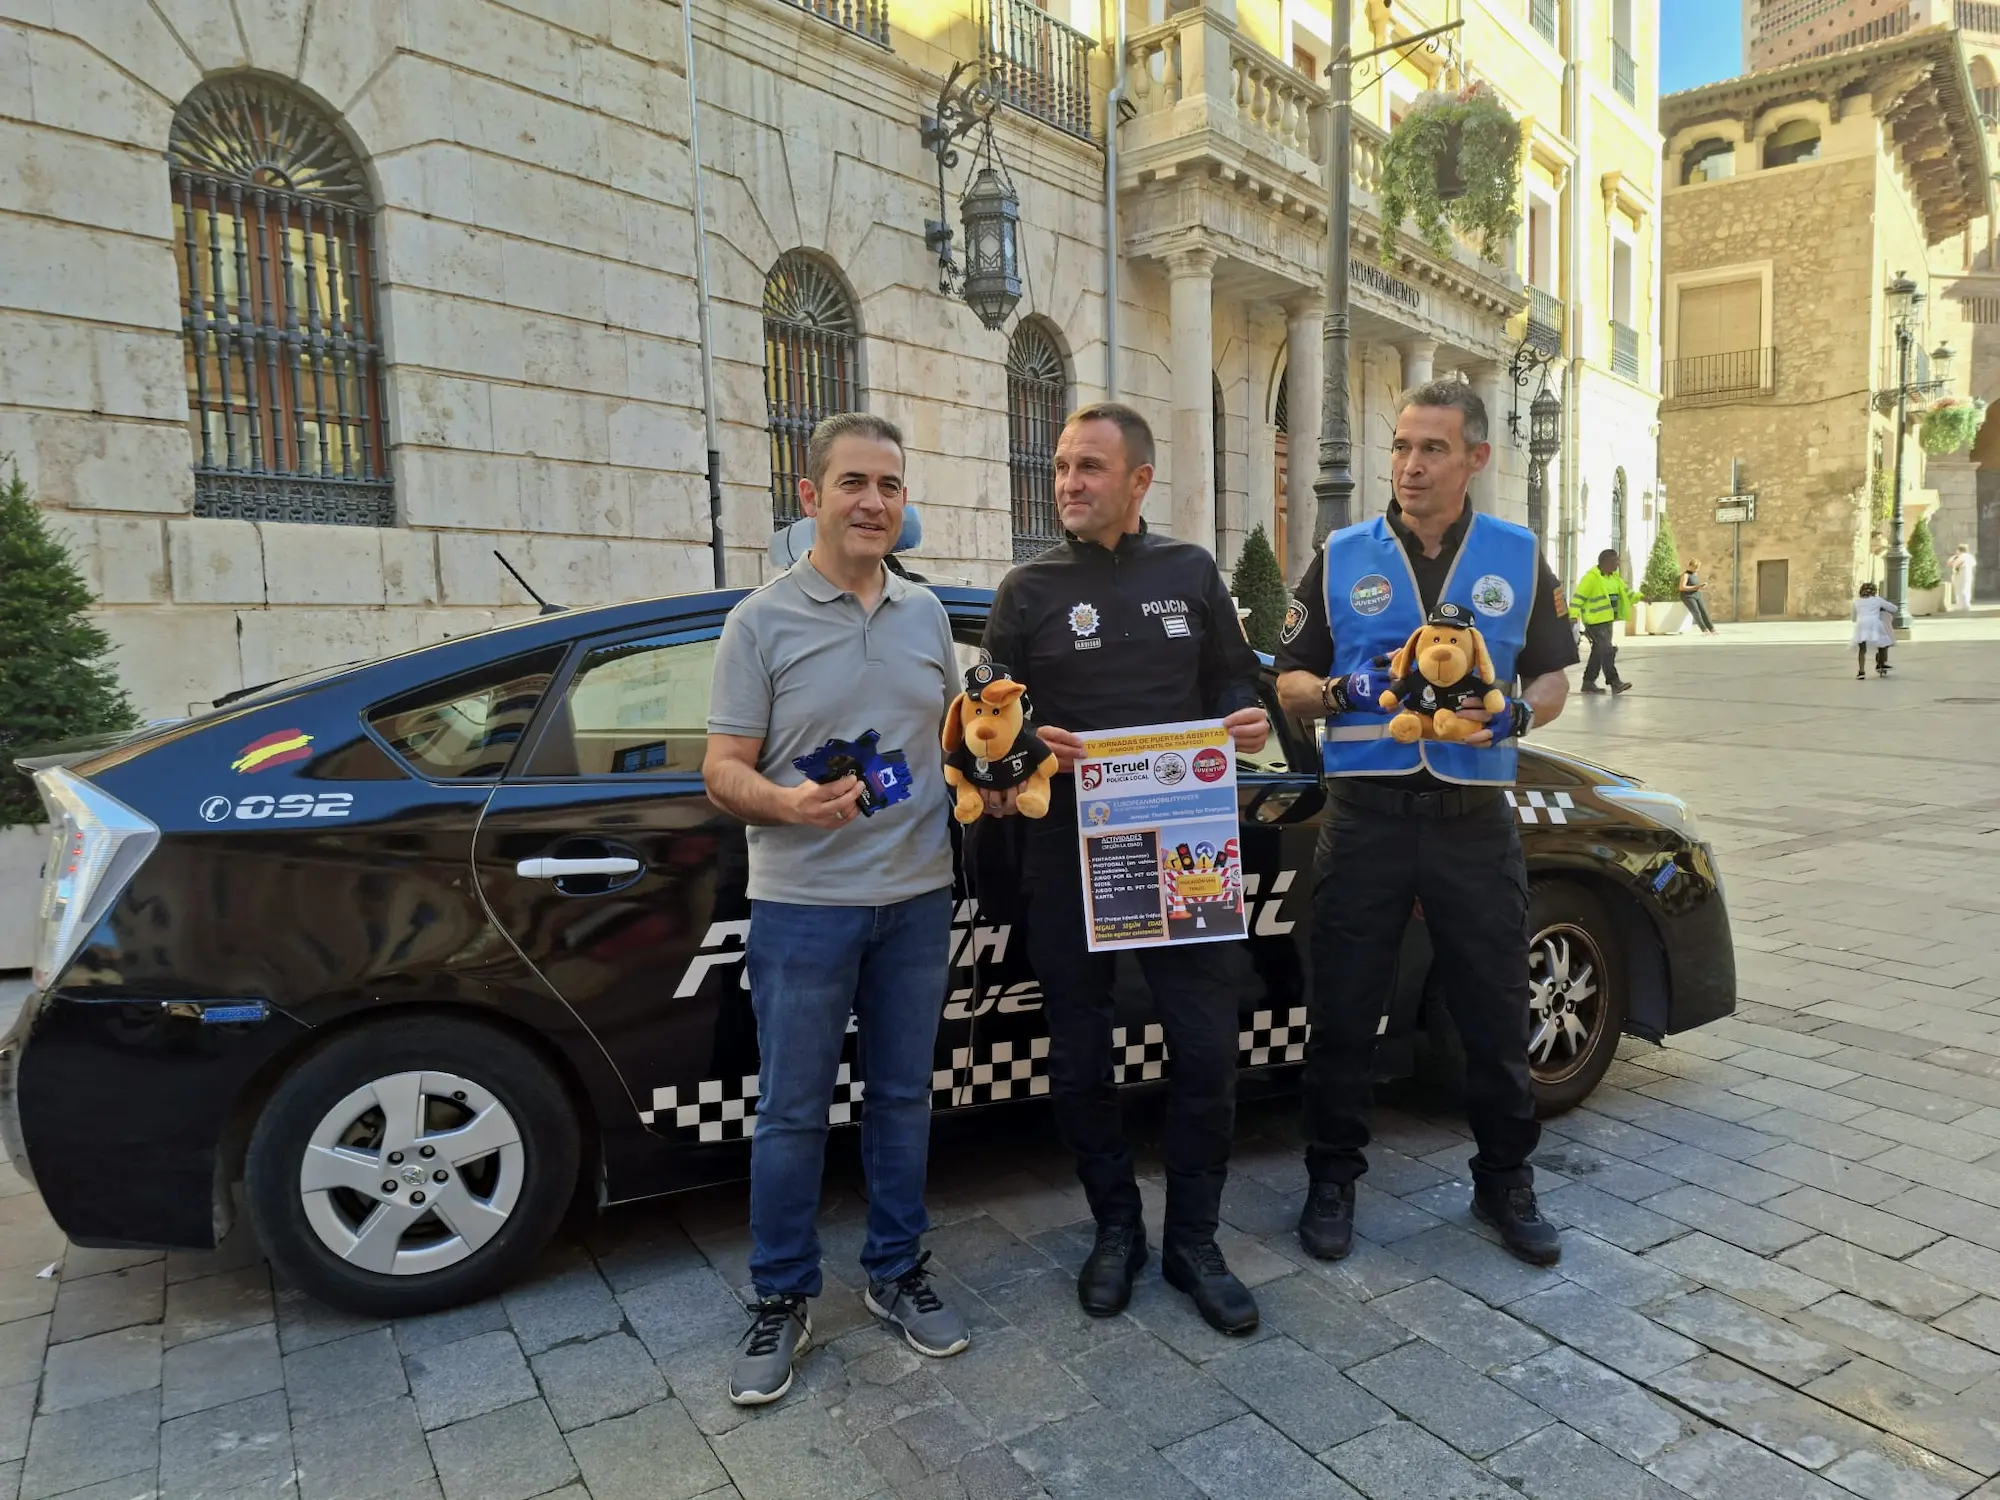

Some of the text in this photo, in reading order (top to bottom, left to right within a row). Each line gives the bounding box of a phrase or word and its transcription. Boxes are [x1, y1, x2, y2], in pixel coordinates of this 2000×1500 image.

[1350, 259, 1420, 308] AYUNTAMIENTO
[1098, 739, 1138, 748] JORNADAS
[1150, 734, 1184, 743] PUERTAS
[1186, 730, 1225, 739] ABIERTAS
[1103, 759, 1149, 774] Teruel
[235, 793, 354, 819] 092
[1101, 834, 1143, 844] ACTIVIDADES
